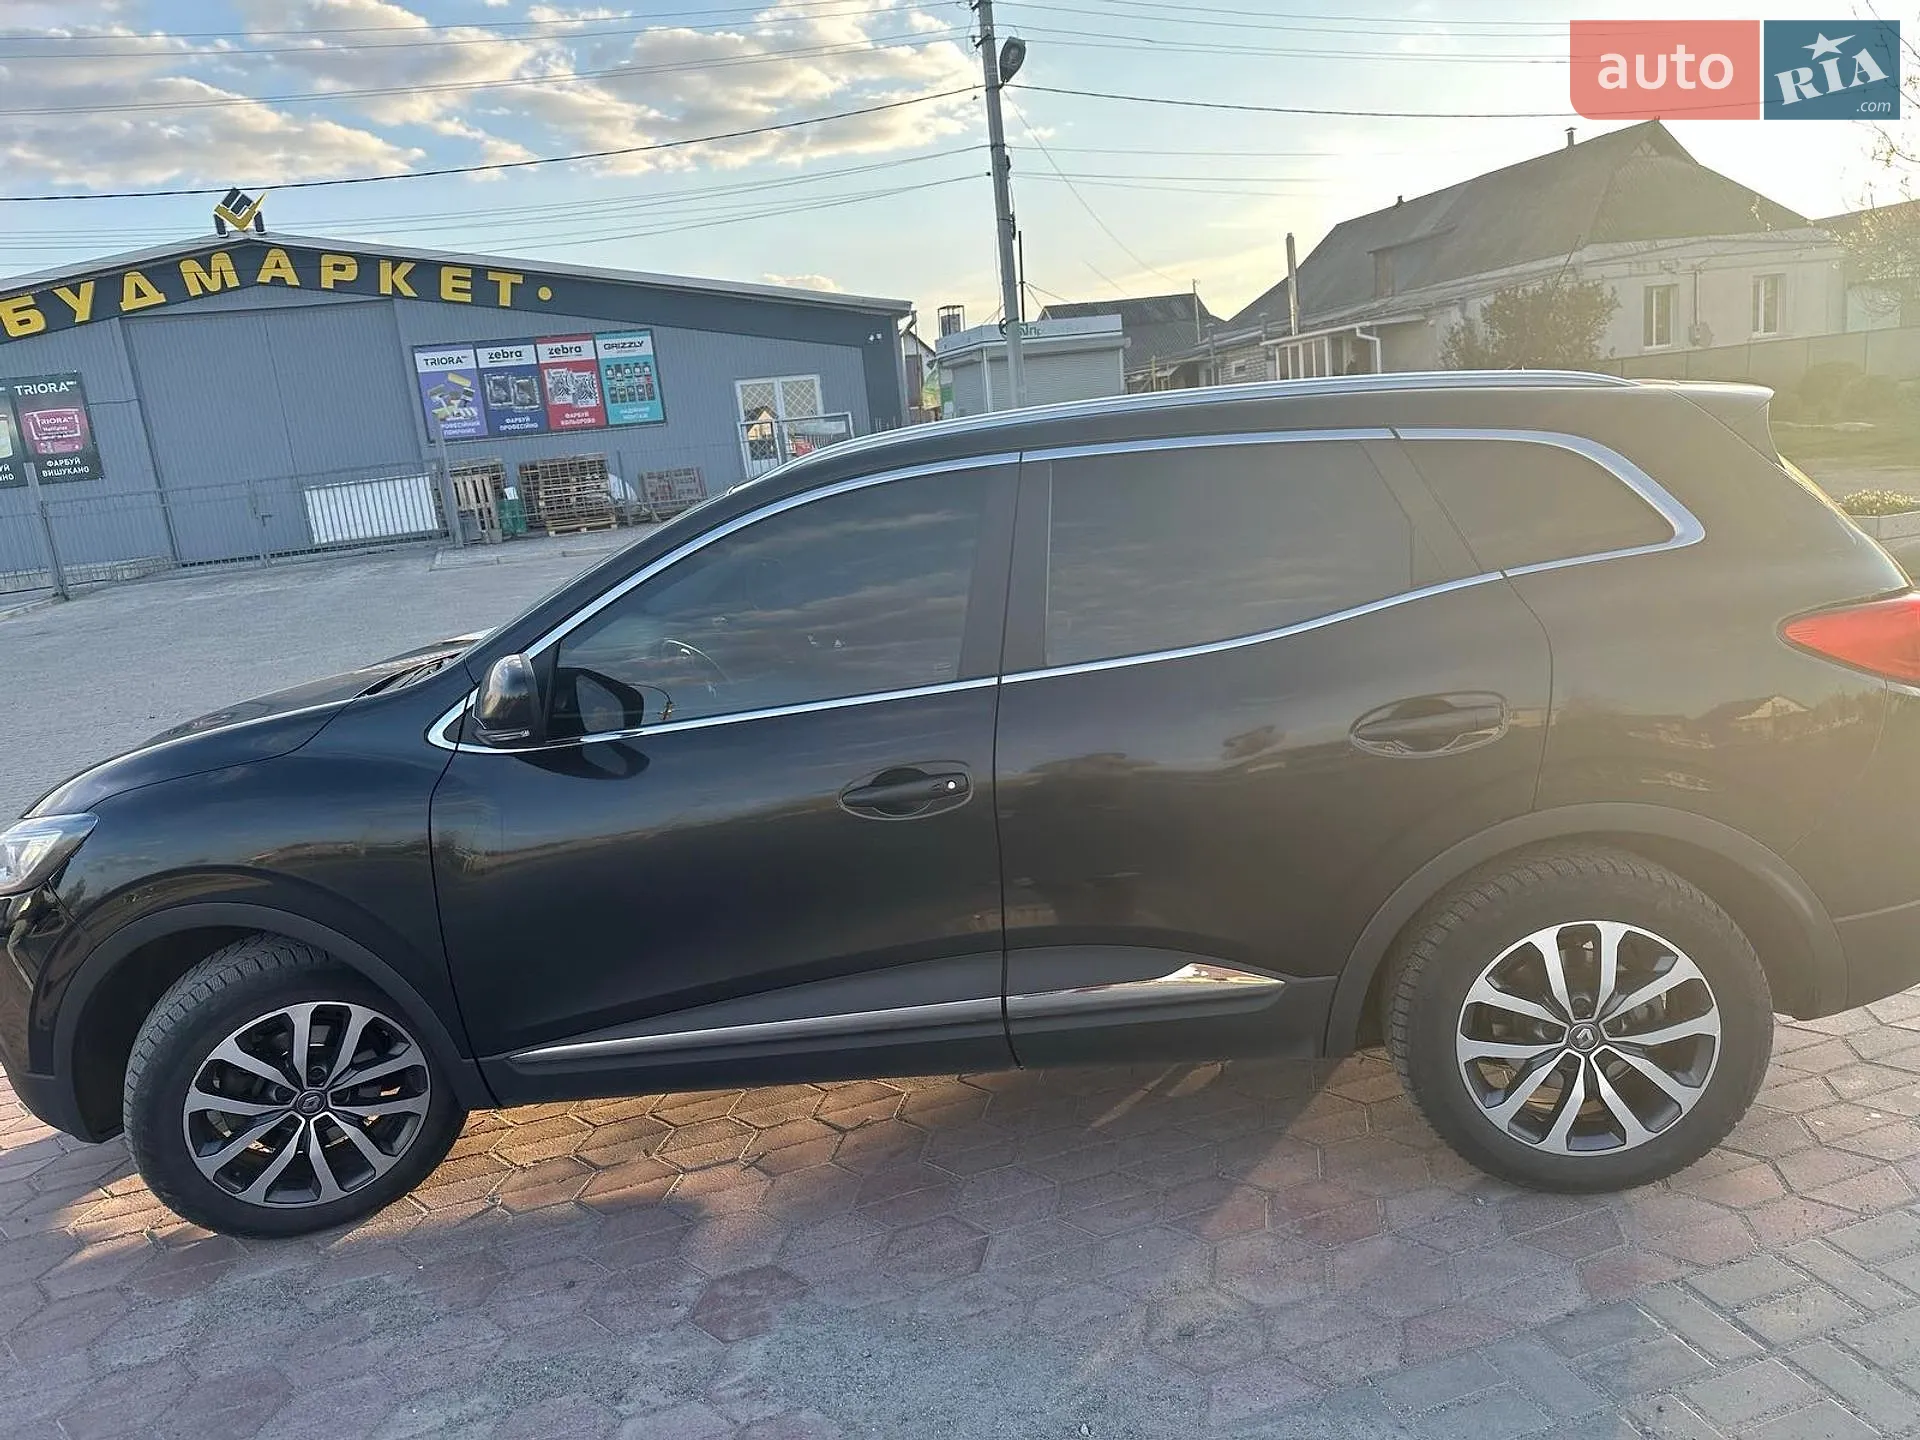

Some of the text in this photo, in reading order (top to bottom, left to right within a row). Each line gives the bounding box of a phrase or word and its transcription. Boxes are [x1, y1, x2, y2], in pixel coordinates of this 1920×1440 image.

[0, 248, 524, 338] БУДМАРКЕТ
[488, 349, 523, 360] zebra
[548, 344, 582, 355] zebra
[423, 355, 464, 367] TRIORA
[14, 382, 70, 396] TRIORA
[46, 456, 81, 468] ФАРБУЙ
[41, 465, 90, 478] ВИШУКАНО
